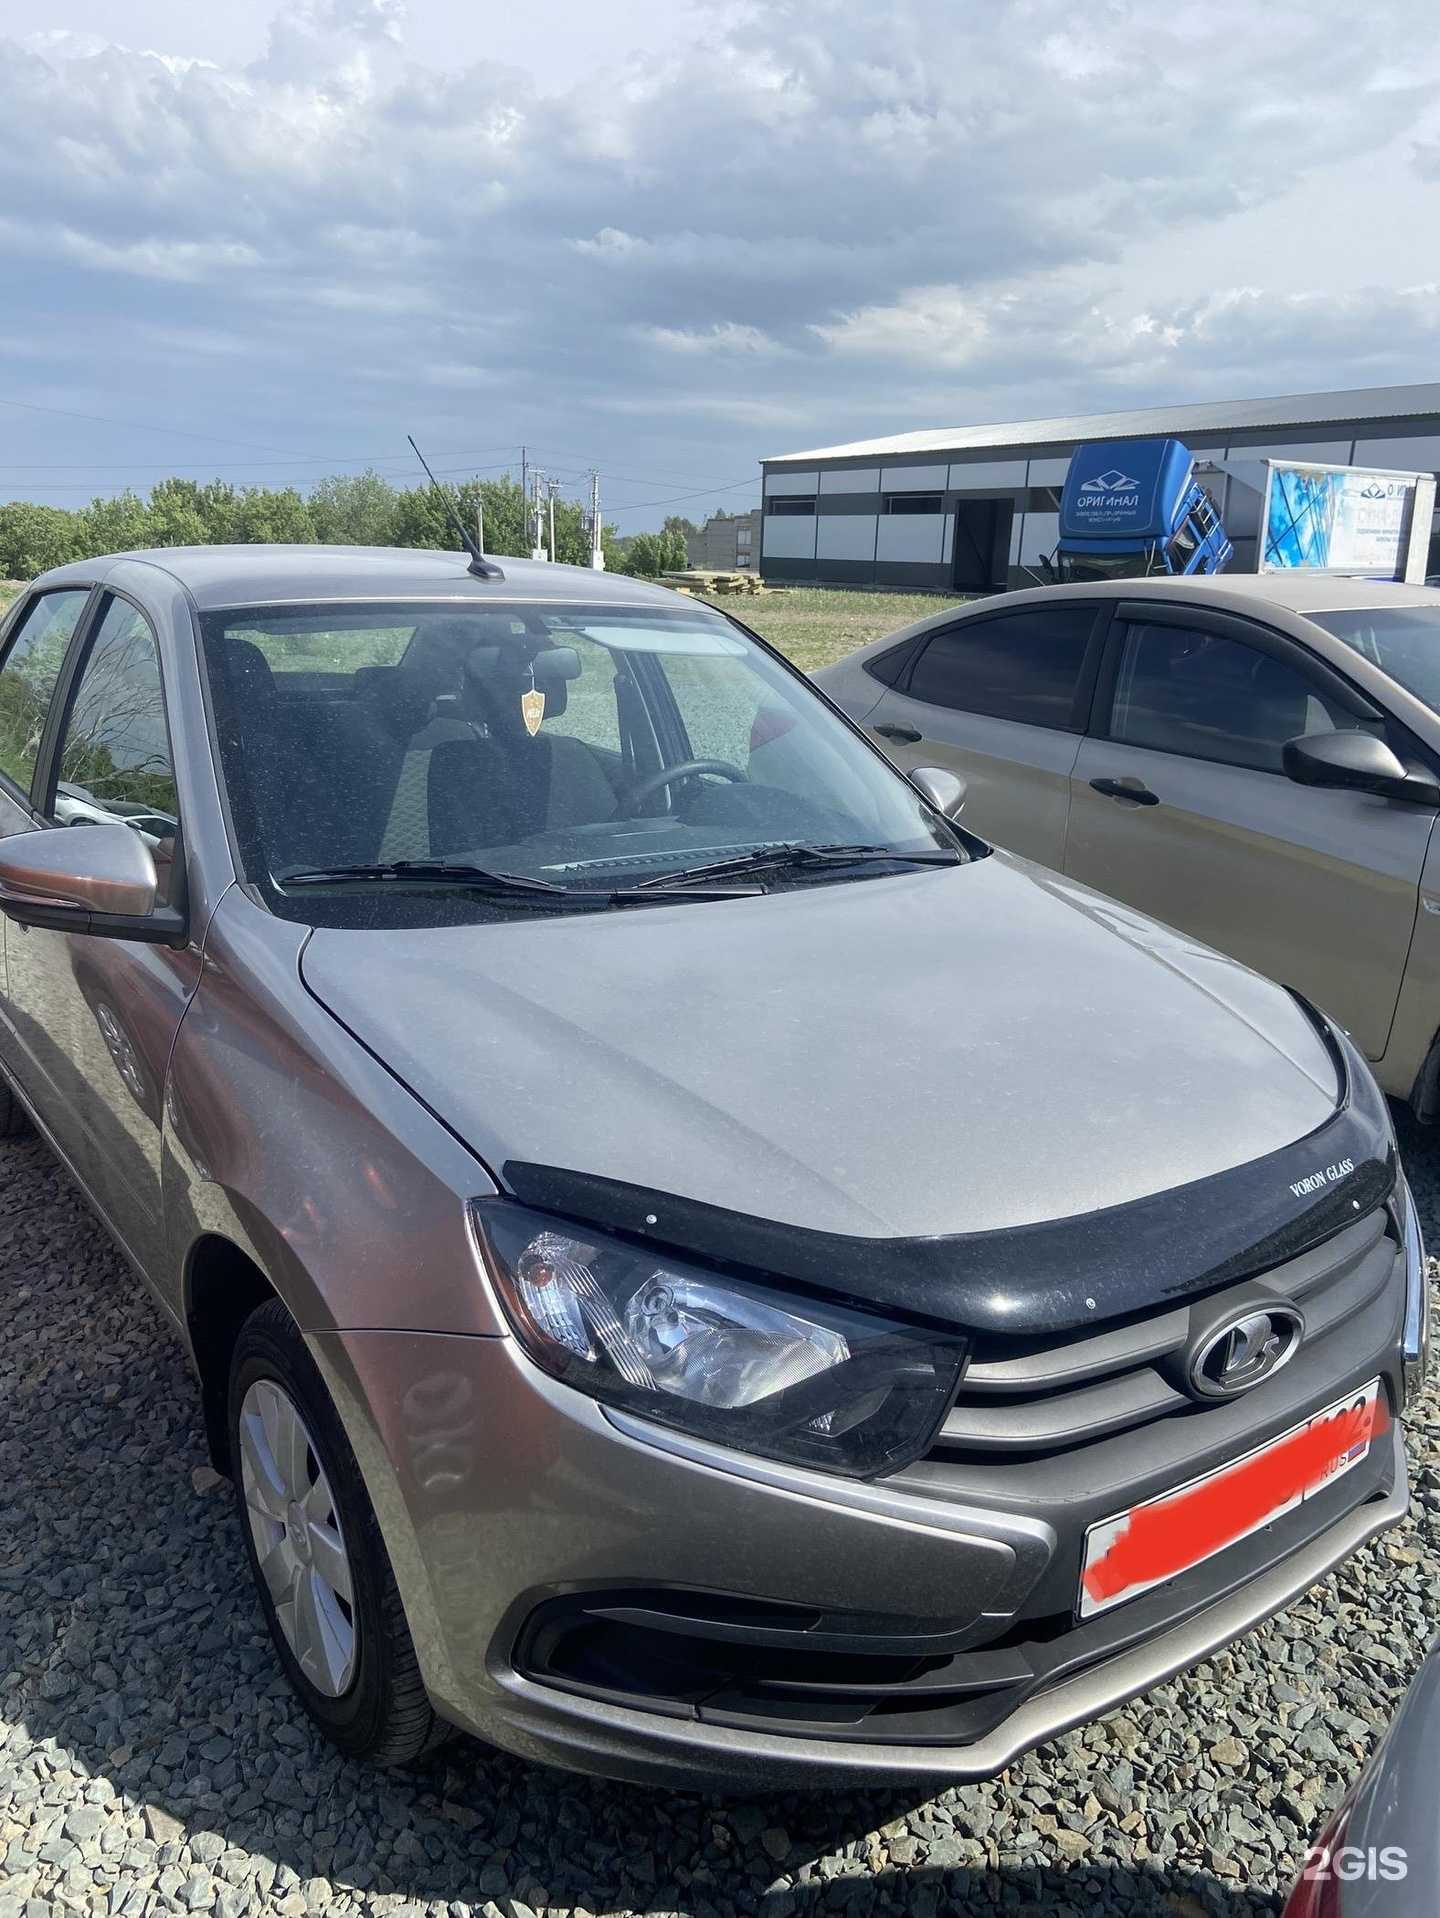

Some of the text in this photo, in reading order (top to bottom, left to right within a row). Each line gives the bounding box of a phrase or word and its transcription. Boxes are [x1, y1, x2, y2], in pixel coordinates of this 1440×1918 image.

[1076, 495, 1139, 508] ОРИГИНАЛ
[1289, 1158, 1354, 1198] VORON GLASS
